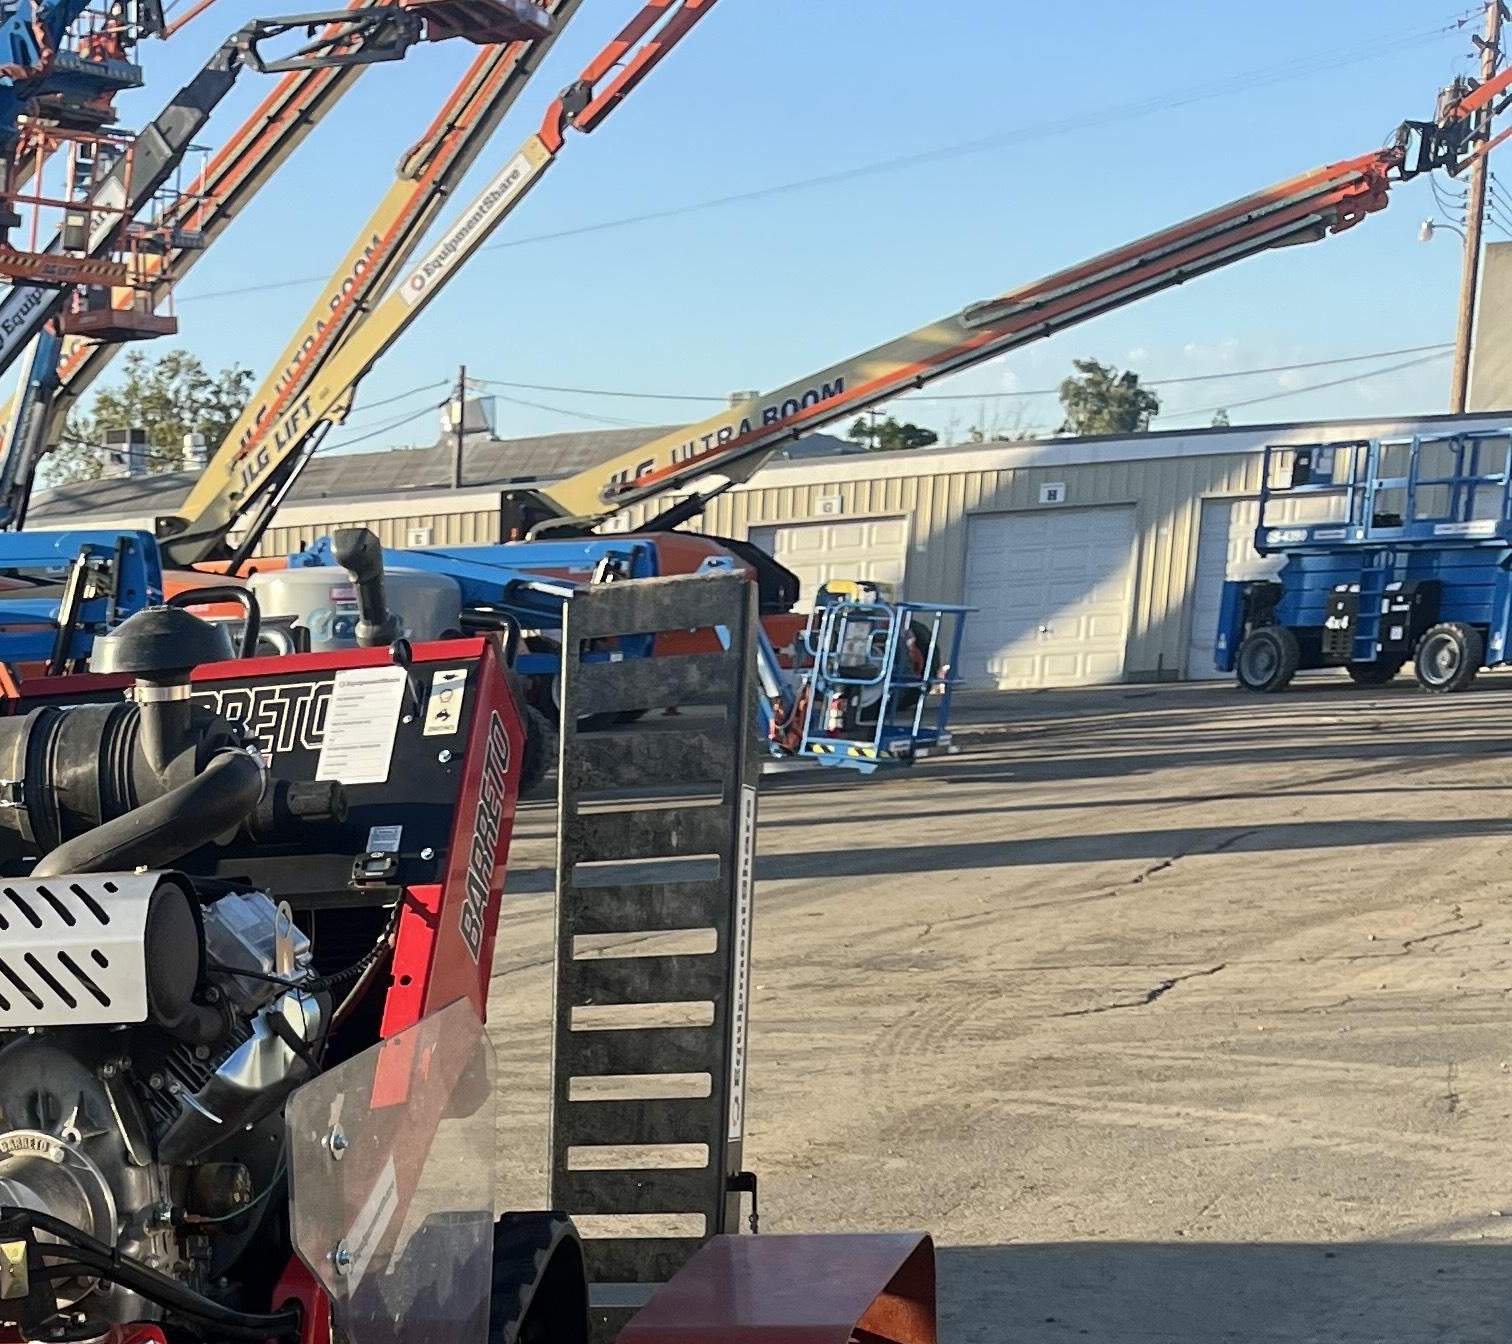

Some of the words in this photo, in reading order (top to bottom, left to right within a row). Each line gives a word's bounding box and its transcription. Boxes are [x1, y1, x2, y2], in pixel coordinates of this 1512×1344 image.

[423, 168, 521, 279] EquipmentShare
[239, 451, 271, 493] JLG
[273, 396, 314, 452] LIFT
[670, 418, 753, 466] ULTRA
[762, 376, 845, 427] BOOM
[1047, 488, 1057, 501] H
[458, 710, 511, 966] BARRETO
